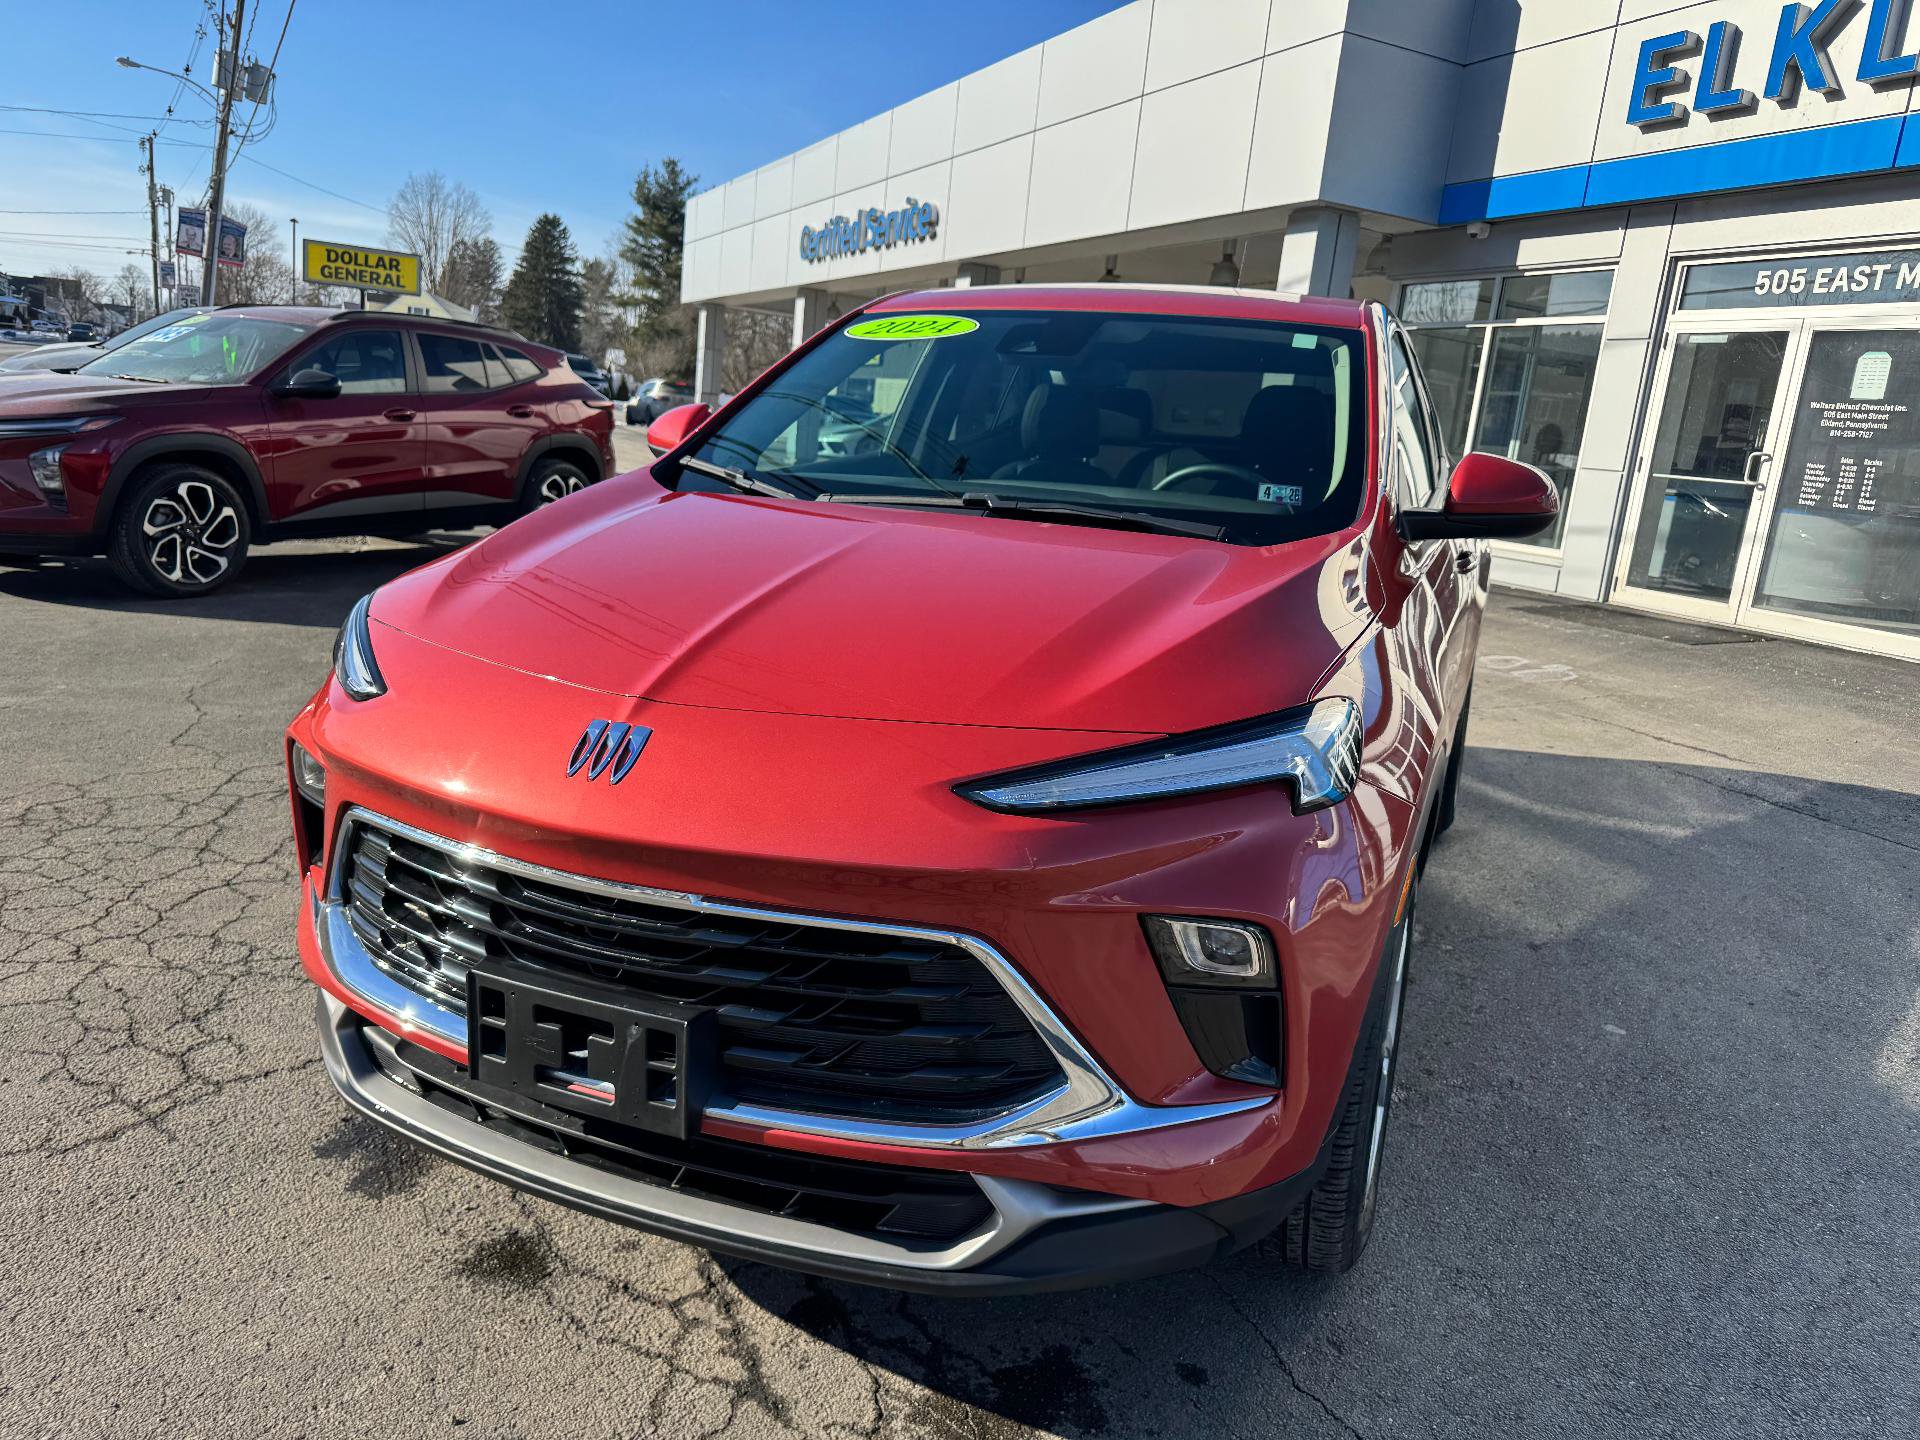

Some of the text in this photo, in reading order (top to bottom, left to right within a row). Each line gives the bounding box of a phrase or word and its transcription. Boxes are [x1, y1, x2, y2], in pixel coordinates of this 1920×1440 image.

[1626, 0, 1920, 127] ELKL
[800, 197, 936, 260] Certified Service
[325, 247, 401, 273] DOLLAR
[320, 264, 406, 289] GENERAL
[1754, 267, 1808, 296] 505
[1812, 263, 1892, 294] EAST
[180, 297, 199, 308] 35
[863, 320, 961, 335] 2024
[1861, 403, 1893, 412] Chevrolet
[1836, 411, 1851, 419] East
[1868, 412, 1889, 420] Street
[1845, 420, 1888, 430] Pennsylvania
[1829, 429, 1874, 438] 814-258-7127
[1263, 486, 1272, 499] 4
